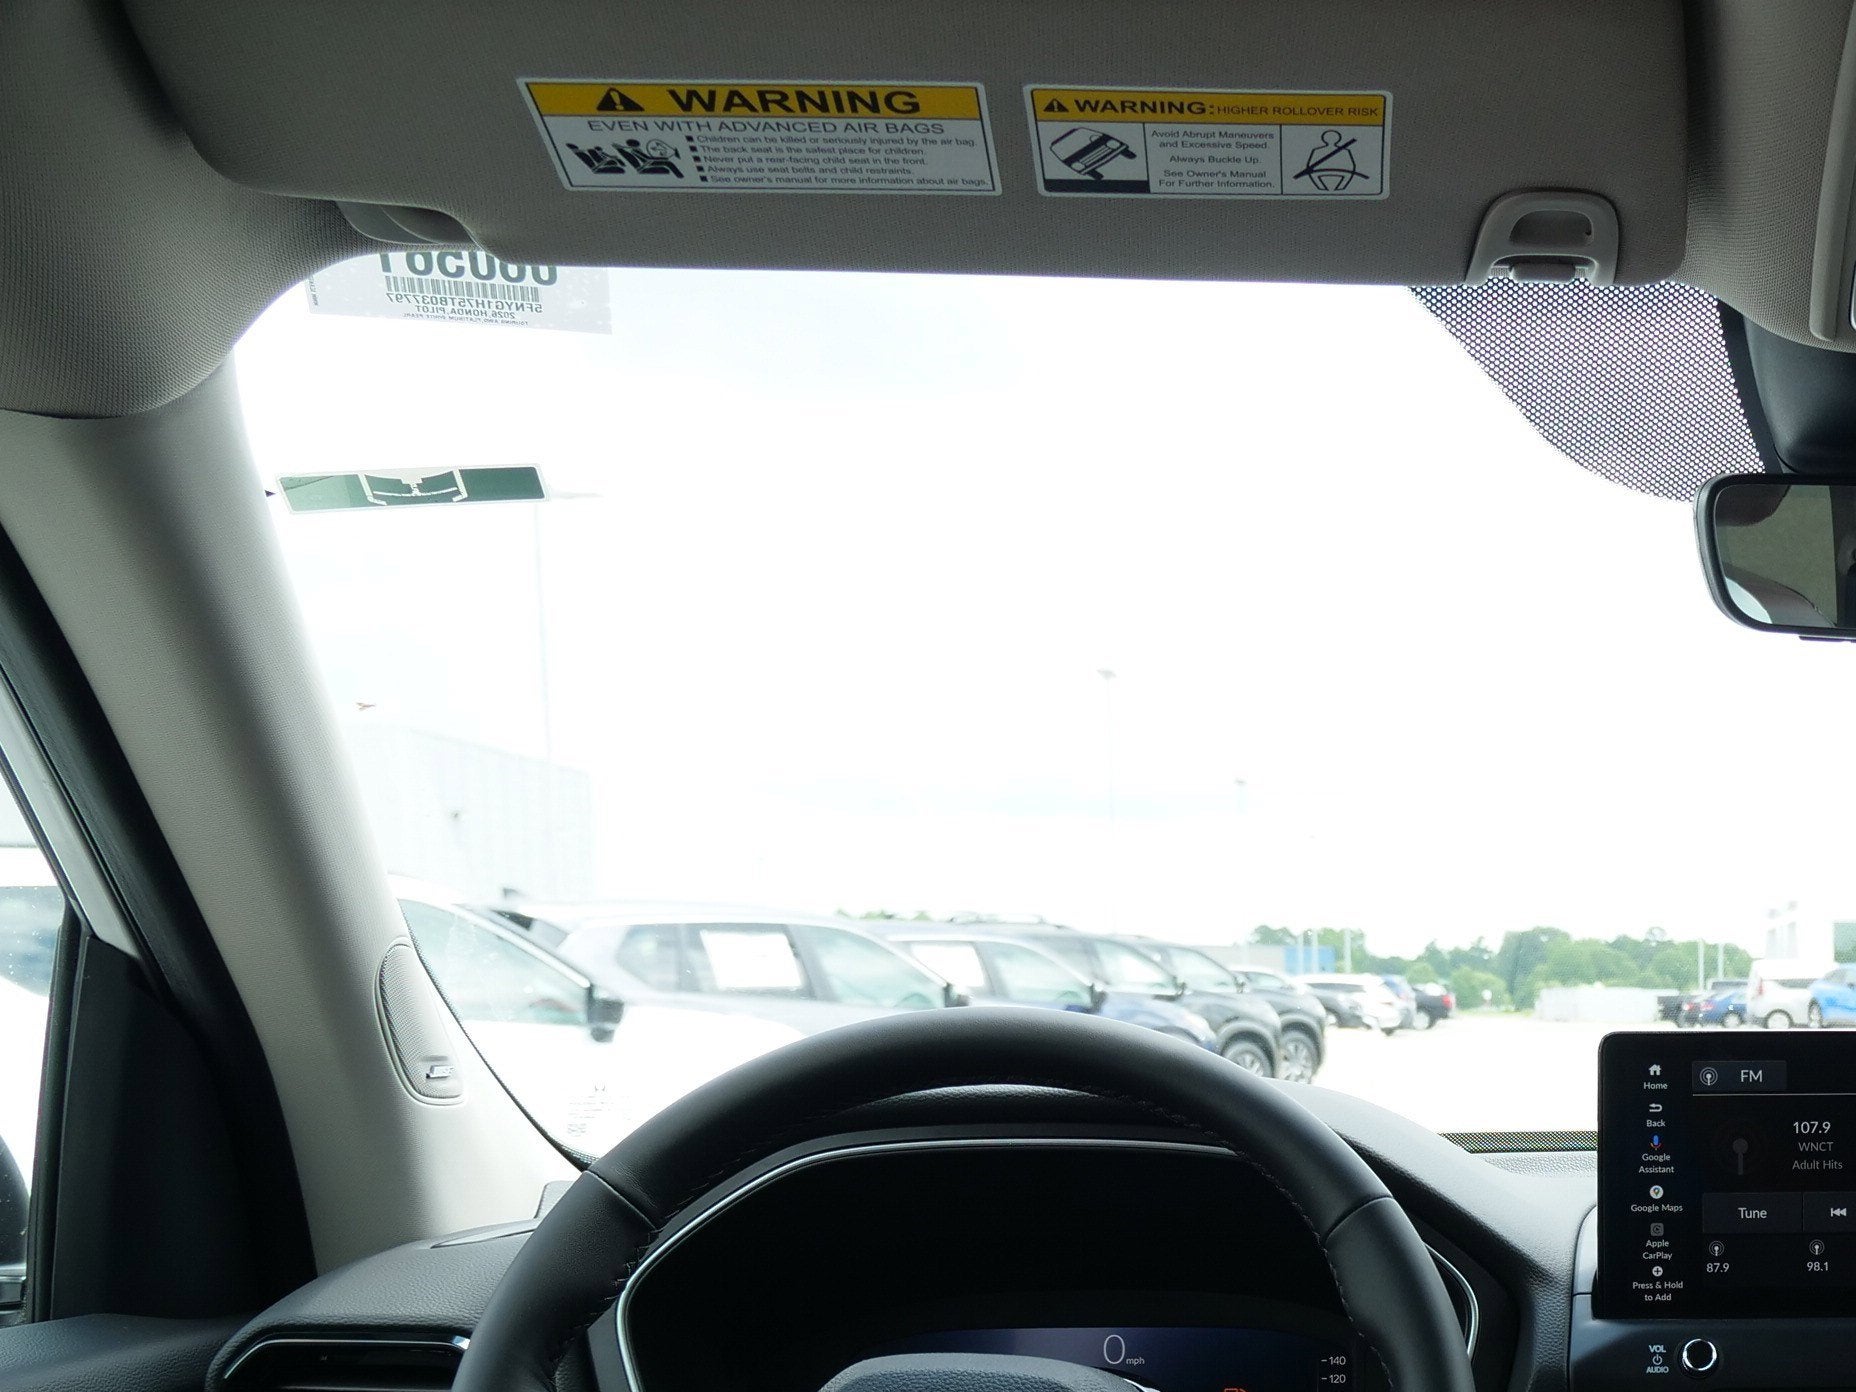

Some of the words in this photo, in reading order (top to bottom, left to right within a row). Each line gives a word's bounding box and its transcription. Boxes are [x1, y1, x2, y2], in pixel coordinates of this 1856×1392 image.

[667, 88, 921, 115] WARNING
[1217, 106, 1268, 115] HIGHER
[1272, 106, 1344, 116] ROLLOVER
[1348, 107, 1378, 117] RISK
[588, 119, 649, 132] EVEN
[654, 120, 713, 133] WITH
[717, 121, 838, 134] ADVANCED
[843, 122, 880, 135] AIR
[885, 122, 946, 136] BAGS
[1151, 130, 1179, 139] Avoid
[1182, 130, 1216, 141] Abrupt
[1218, 131, 1274, 140] Maneuvers
[1181, 141, 1231, 149] Excessive
[1169, 156, 1204, 165] Always
[1207, 156, 1240, 164] Buckle
[1163, 170, 1184, 178] See
[1186, 170, 1228, 178] Owner's
[1230, 170, 1266, 178] Manual
[1158, 180, 1175, 188] For
[1178, 180, 1215, 188] Further
[1740, 1070, 1763, 1083] FM
[1643, 1082, 1668, 1090] Home
[1646, 1119, 1666, 1127] Back
[1793, 1121, 1831, 1134] 107.9
[1798, 1142, 1834, 1152] WNCT
[1641, 1153, 1671, 1162] Google
[1638, 1165, 1675, 1174] Assistant
[1792, 1160, 1820, 1170] Adult
[1823, 1159, 1843, 1170] Hits
[1630, 1204, 1659, 1213] Google
[1662, 1203, 1683, 1213] Maps
[1738, 1207, 1767, 1219] Tune
[1646, 1239, 1670, 1248] Apple
[1642, 1251, 1673, 1261] CarPlay
[1706, 1263, 1730, 1273] 87.9
[1806, 1262, 1829, 1272] 98.1
[1633, 1281, 1654, 1290] Press
[1655, 1281, 1662, 1290] &
[1664, 1281, 1683, 1289] Hold
[1104, 1334, 1126, 1364] 0
[1649, 1345, 1666, 1353] VOL
[1126, 1357, 1145, 1366] mph
[1328, 1356, 1346, 1365] 140
[1646, 1366, 1669, 1374] AUDIO
[1328, 1374, 1346, 1384] 120
